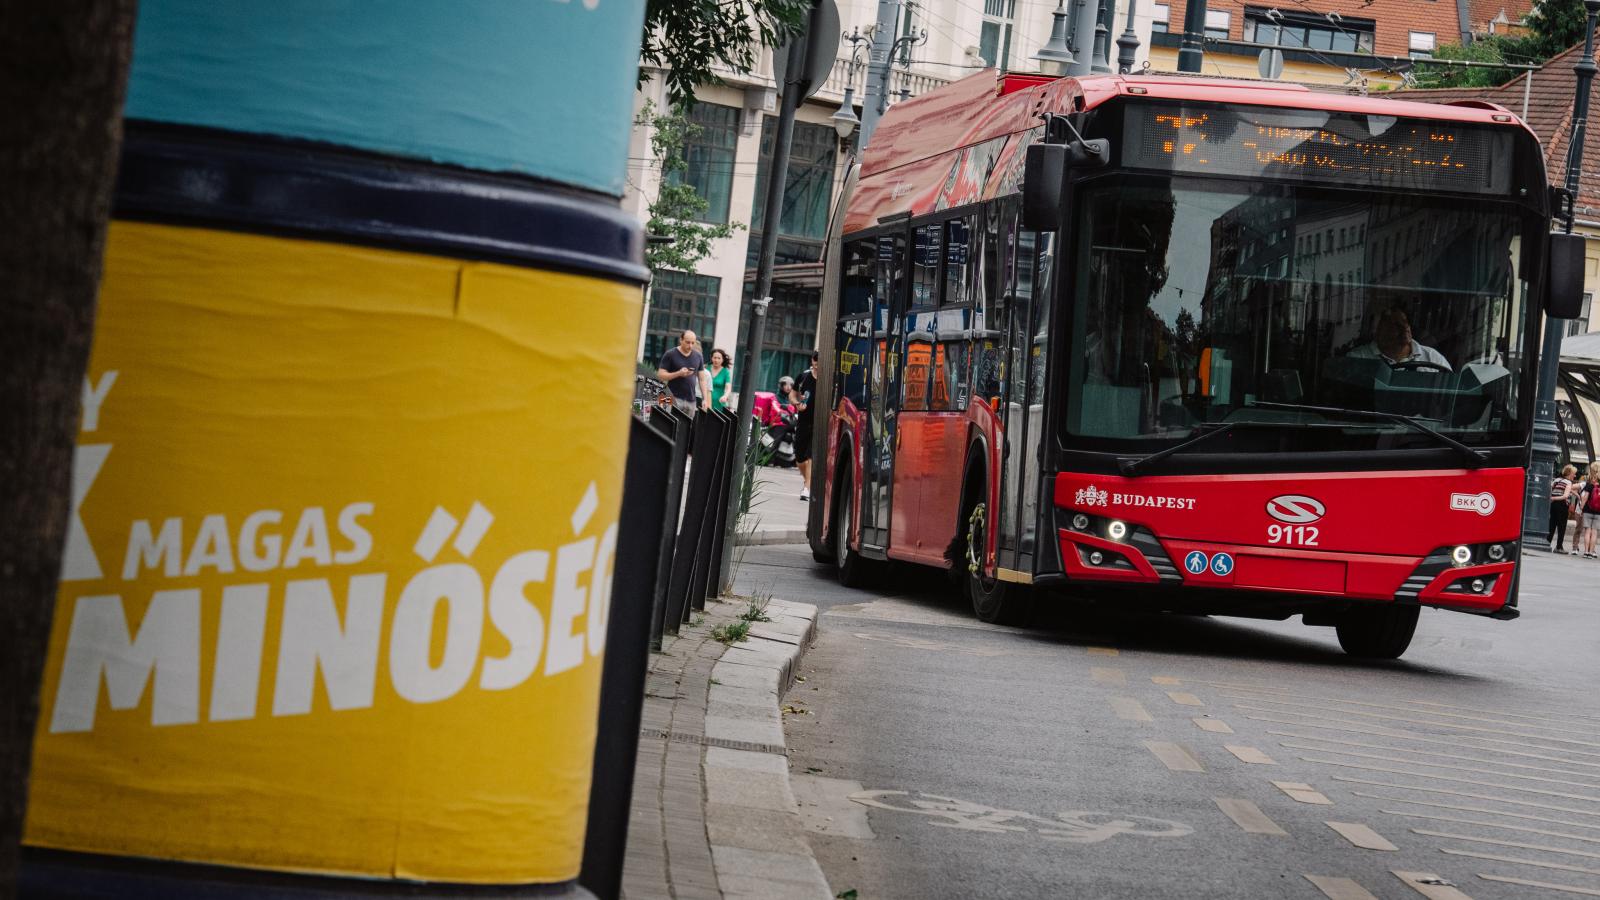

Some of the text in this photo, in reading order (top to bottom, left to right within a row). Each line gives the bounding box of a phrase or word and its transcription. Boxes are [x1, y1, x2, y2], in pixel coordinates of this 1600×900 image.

[1112, 493, 1196, 511] BUDAPEST
[122, 502, 375, 580] MAGAS
[1267, 524, 1320, 547] 9112
